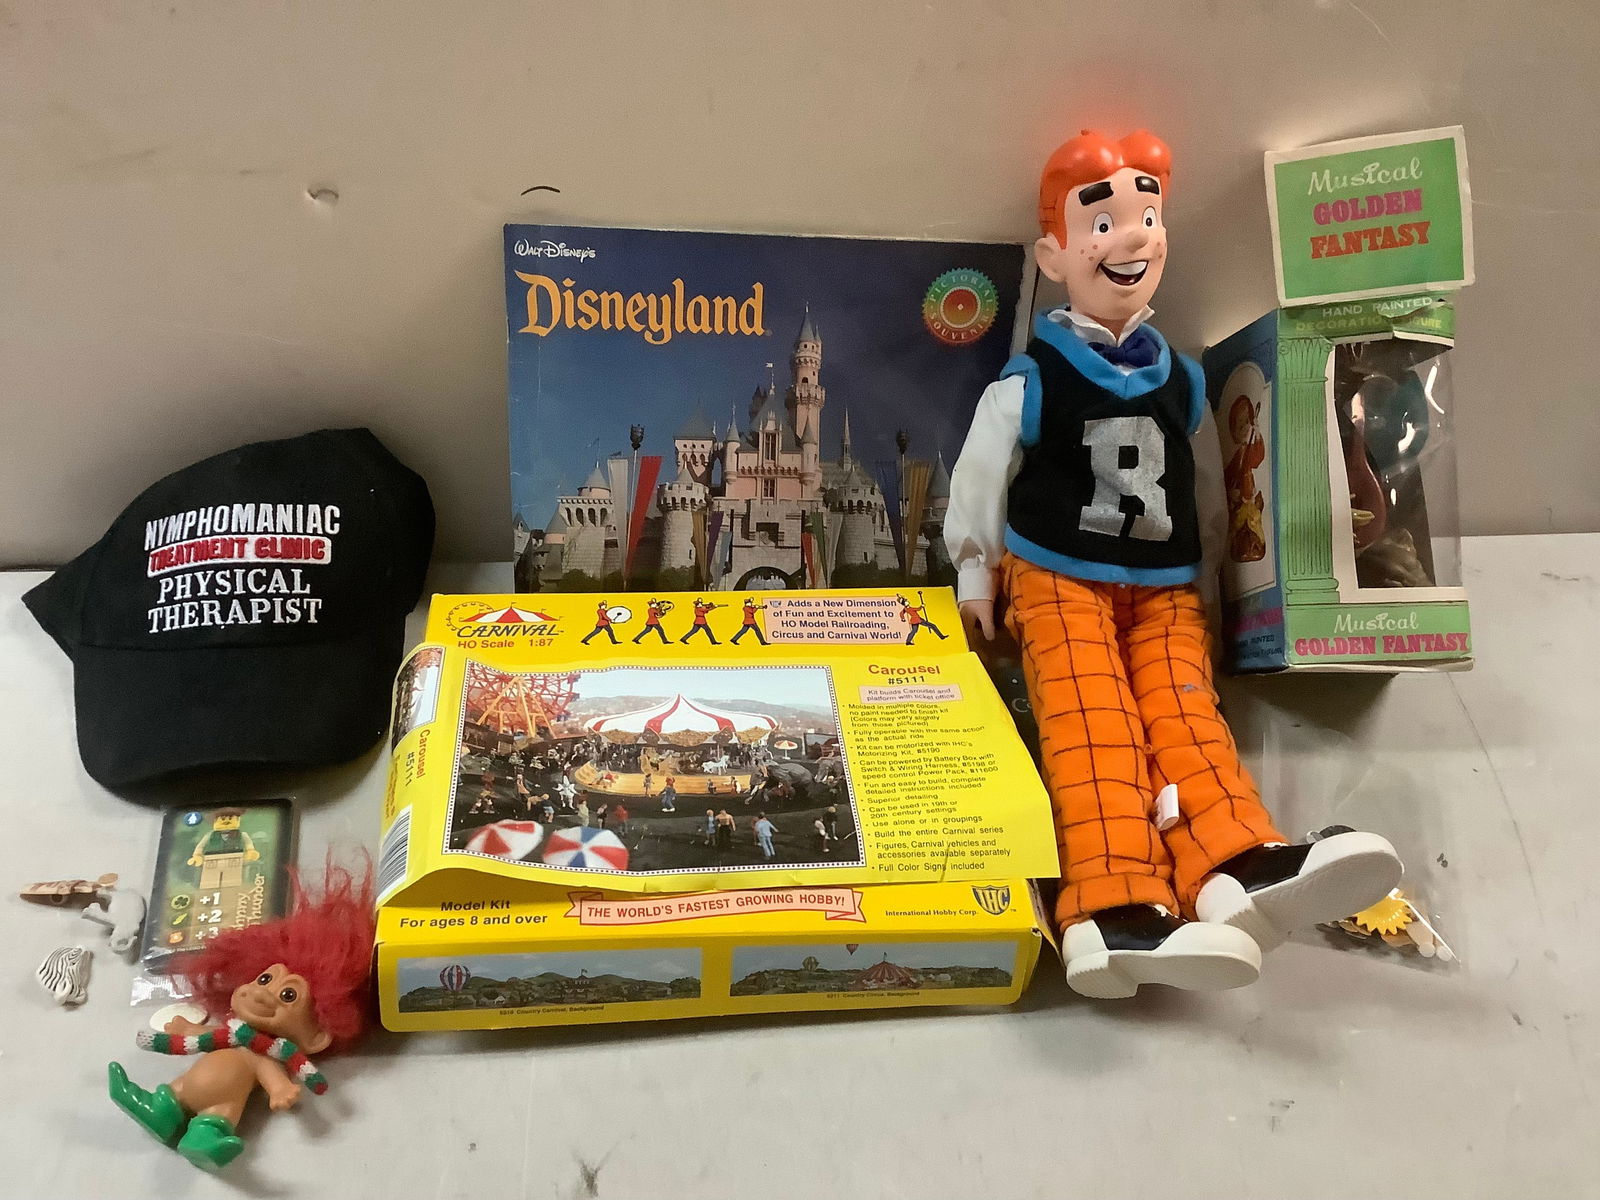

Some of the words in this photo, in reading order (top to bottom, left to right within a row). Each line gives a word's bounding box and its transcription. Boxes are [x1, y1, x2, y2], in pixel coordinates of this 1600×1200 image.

[1308, 157, 1422, 195] Musical
[1314, 188, 1422, 225] GOLDEN
[1310, 221, 1430, 259] FANTASY
[930, 275, 992, 303] PICTORIAL
[514, 270, 765, 345] Disneyland
[1323, 305, 1362, 317] HAND
[1373, 297, 1432, 312] PAINTED
[930, 312, 989, 340] SOUVENIR
[1079, 416, 1172, 541] R
[145, 504, 340, 550] NYMPHOMANIAC
[151, 538, 248, 571] TREATMENT
[255, 537, 325, 559] CLINIC
[157, 569, 310, 603] PHYSICAL
[148, 598, 322, 633] THERAPIST
[832, 621, 889, 630] Railroading,
[1334, 612, 1419, 633] Musical
[457, 624, 559, 637] CARNIVAL
[828, 631, 867, 639] Carnival
[481, 639, 514, 648] Scale
[1295, 637, 1376, 656] GOLDEN
[1383, 633, 1468, 653] FANTASY
[868, 665, 940, 675] Carousel
[888, 676, 925, 684] #5111
[417, 730, 430, 778] Carousel
[405, 752, 415, 786] #5111
[943, 815, 982, 824] groupings
[943, 827, 975, 835] Carnival
[878, 850, 926, 859] accessories
[970, 848, 1010, 857] separately
[898, 863, 919, 871] Color
[924, 862, 946, 871] Signs
[200, 892, 220, 905] +1
[441, 901, 485, 911] Model
[490, 900, 510, 909] Kit
[588, 907, 611, 917] THE
[617, 905, 673, 917] WORLD'S
[678, 899, 730, 913] FASTEST
[733, 894, 793, 906] GROWING
[800, 893, 845, 906] HOBBY!
[976, 888, 1009, 912] IHC
[198, 910, 222, 923] +2
[400, 918, 424, 927] For
[430, 917, 465, 928] ages
[471, 916, 478, 925] 8
[483, 915, 510, 924] and
[515, 915, 548, 923] over
[195, 927, 219, 940] +3
